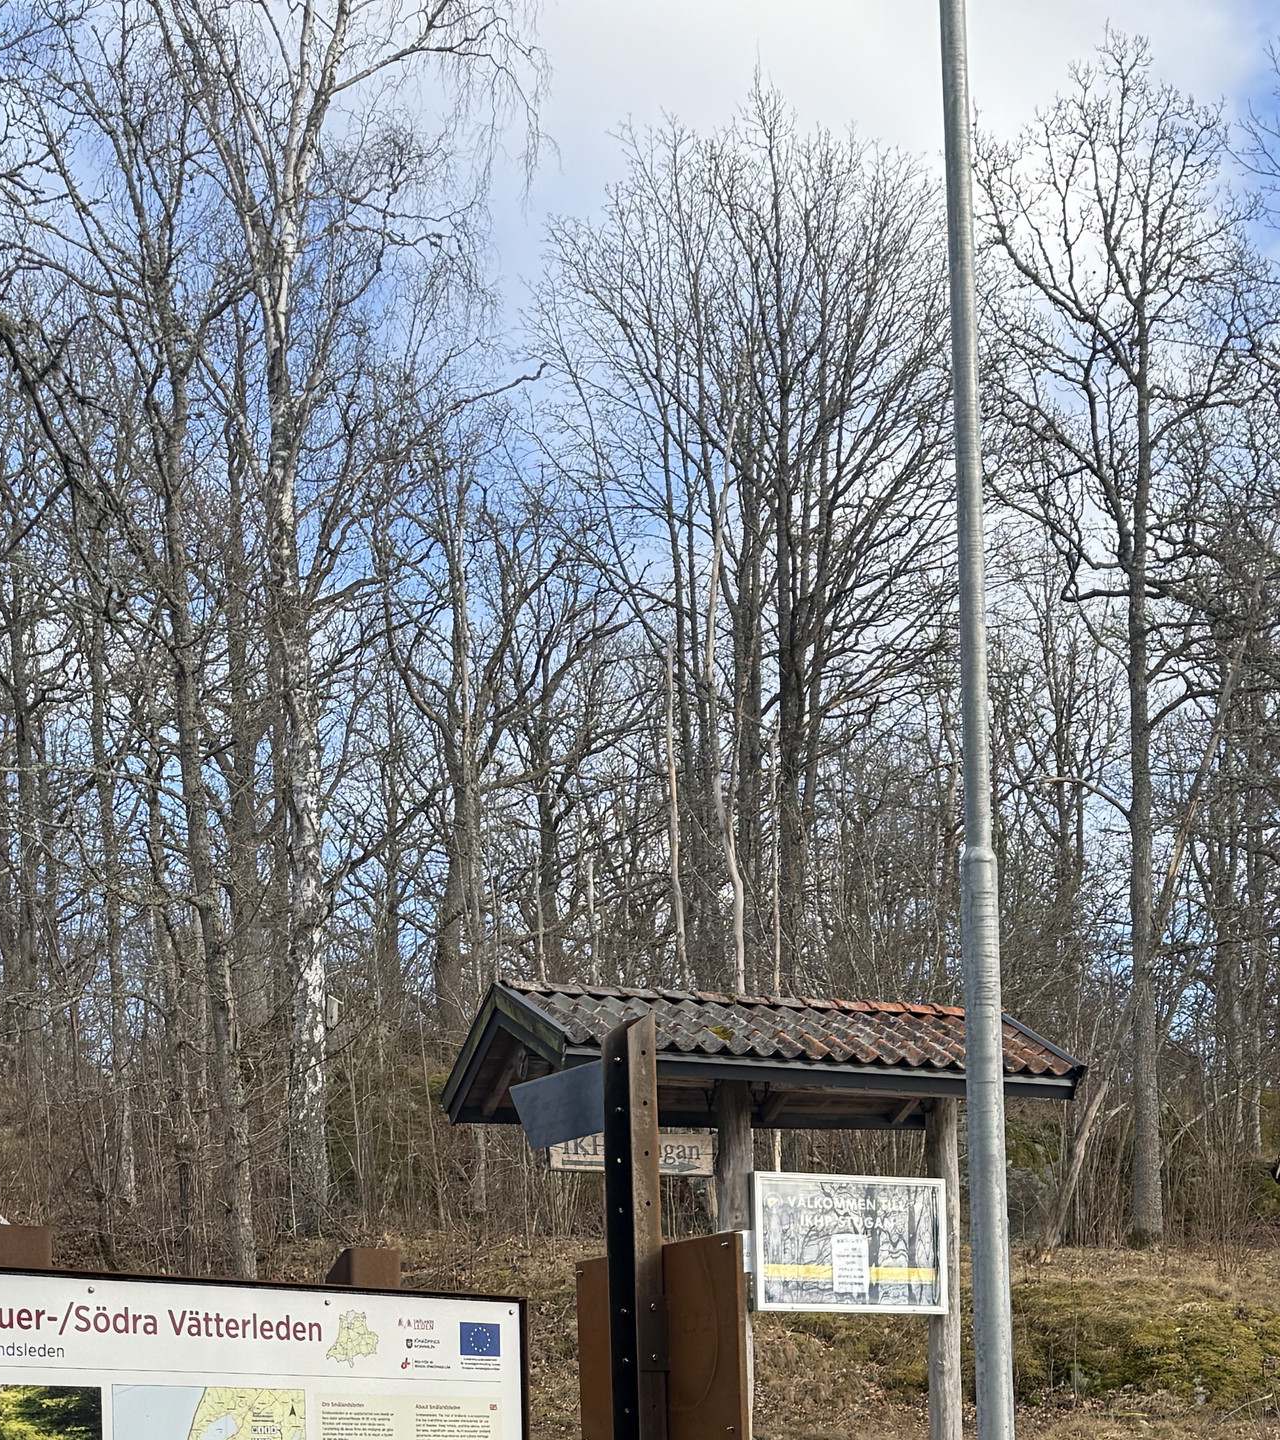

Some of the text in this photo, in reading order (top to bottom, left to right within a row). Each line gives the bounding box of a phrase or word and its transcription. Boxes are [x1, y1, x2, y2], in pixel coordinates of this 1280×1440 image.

[562, 1135, 605, 1155] IKH
[787, 1195, 877, 1211] VÄLKOMMEN
[800, 1214, 895, 1229] IKHP-STUGAN
[168, 1309, 322, 1342] Vätterleden
